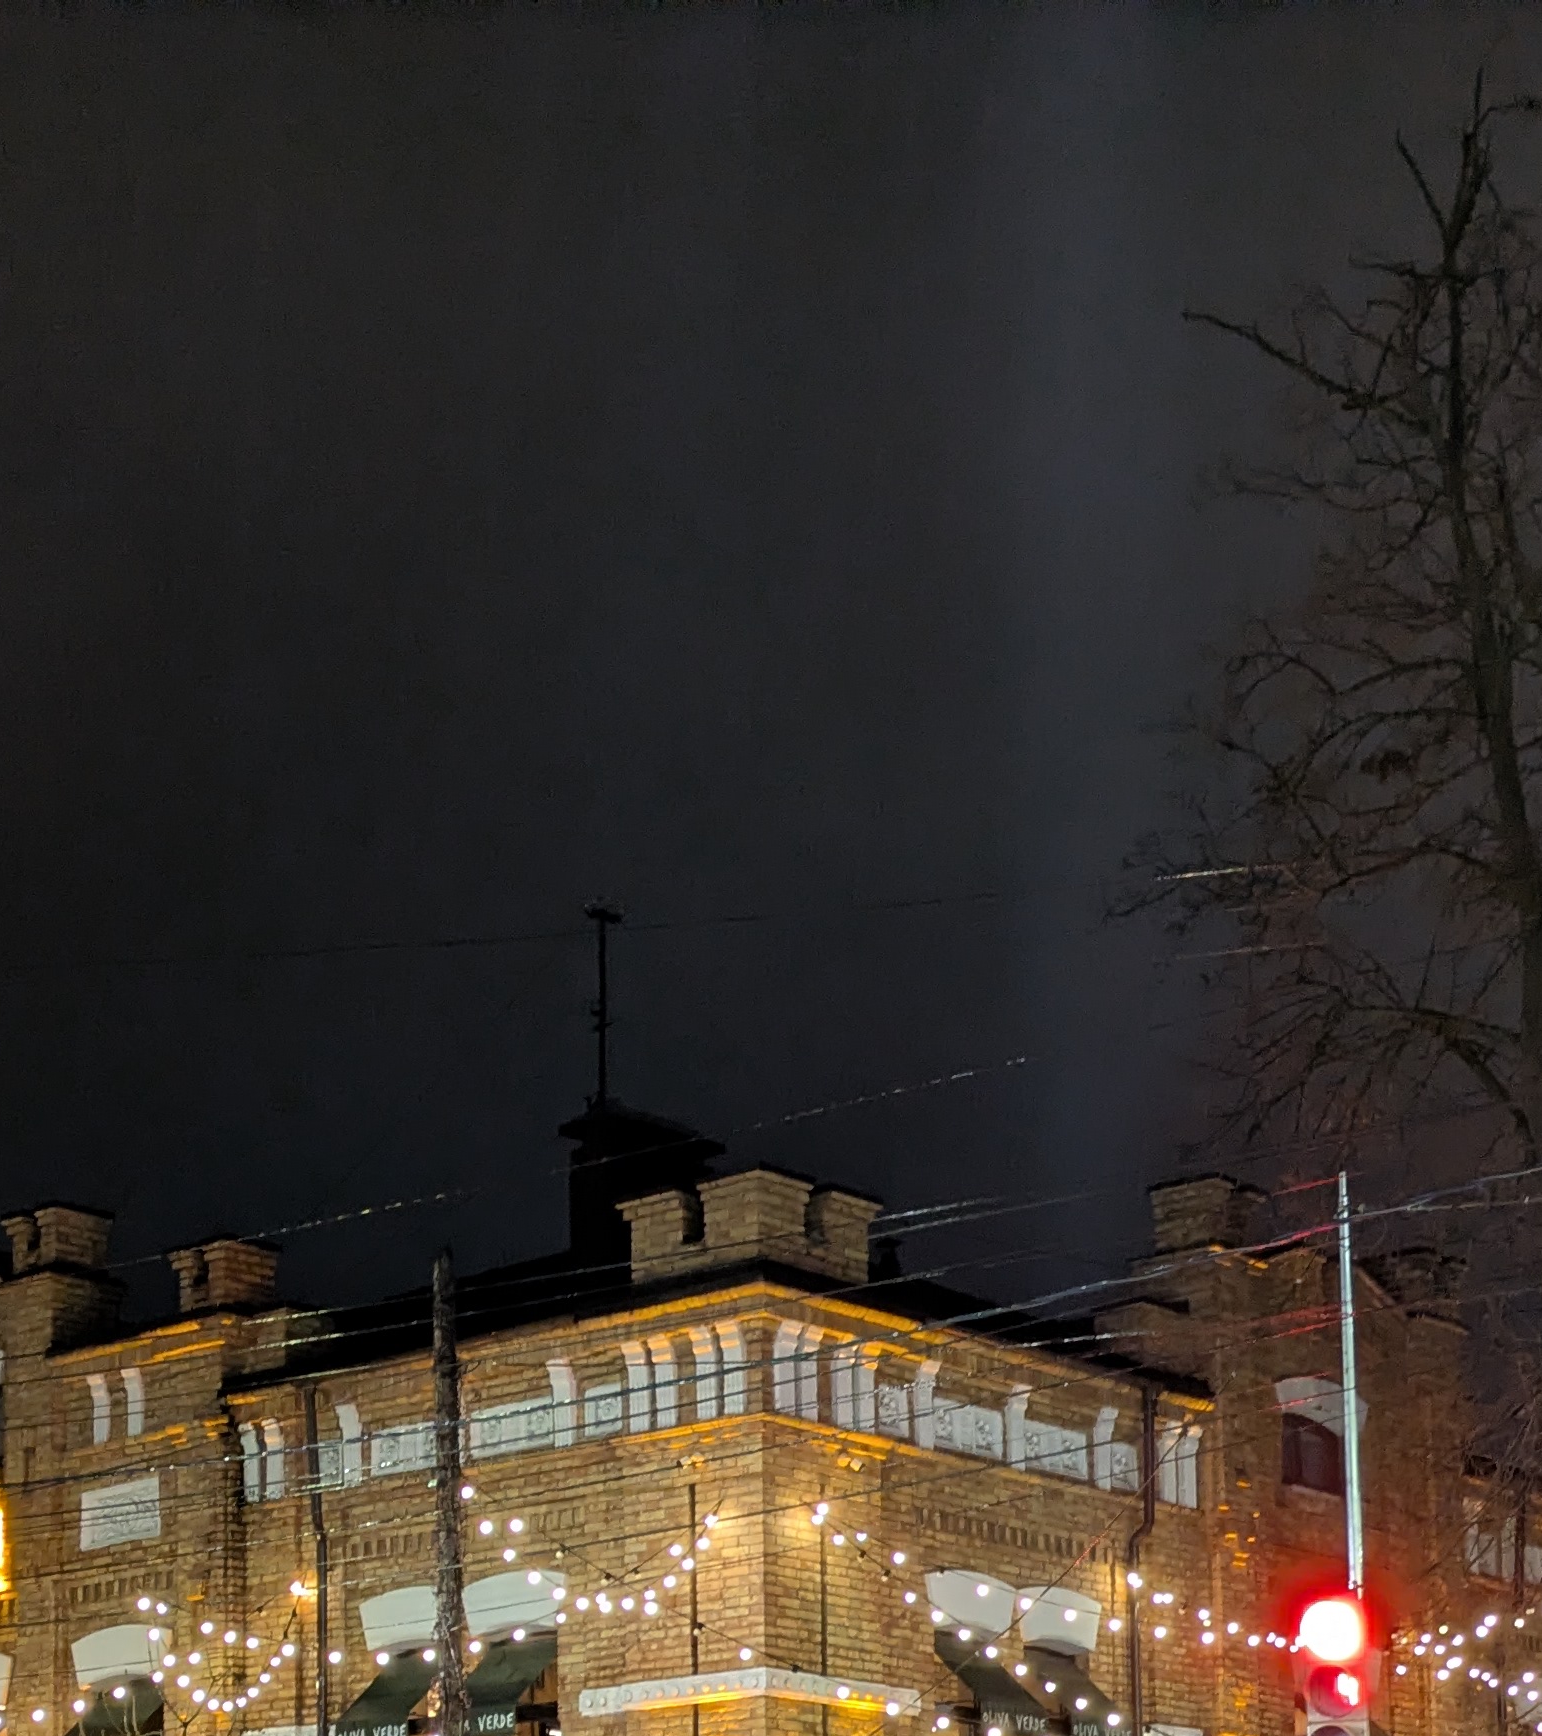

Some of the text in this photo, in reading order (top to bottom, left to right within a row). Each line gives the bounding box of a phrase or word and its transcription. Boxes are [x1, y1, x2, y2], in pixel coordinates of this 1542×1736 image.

[478, 1712, 515, 1732] VERDE
[982, 1710, 1047, 1732] OLIVA VERDE
